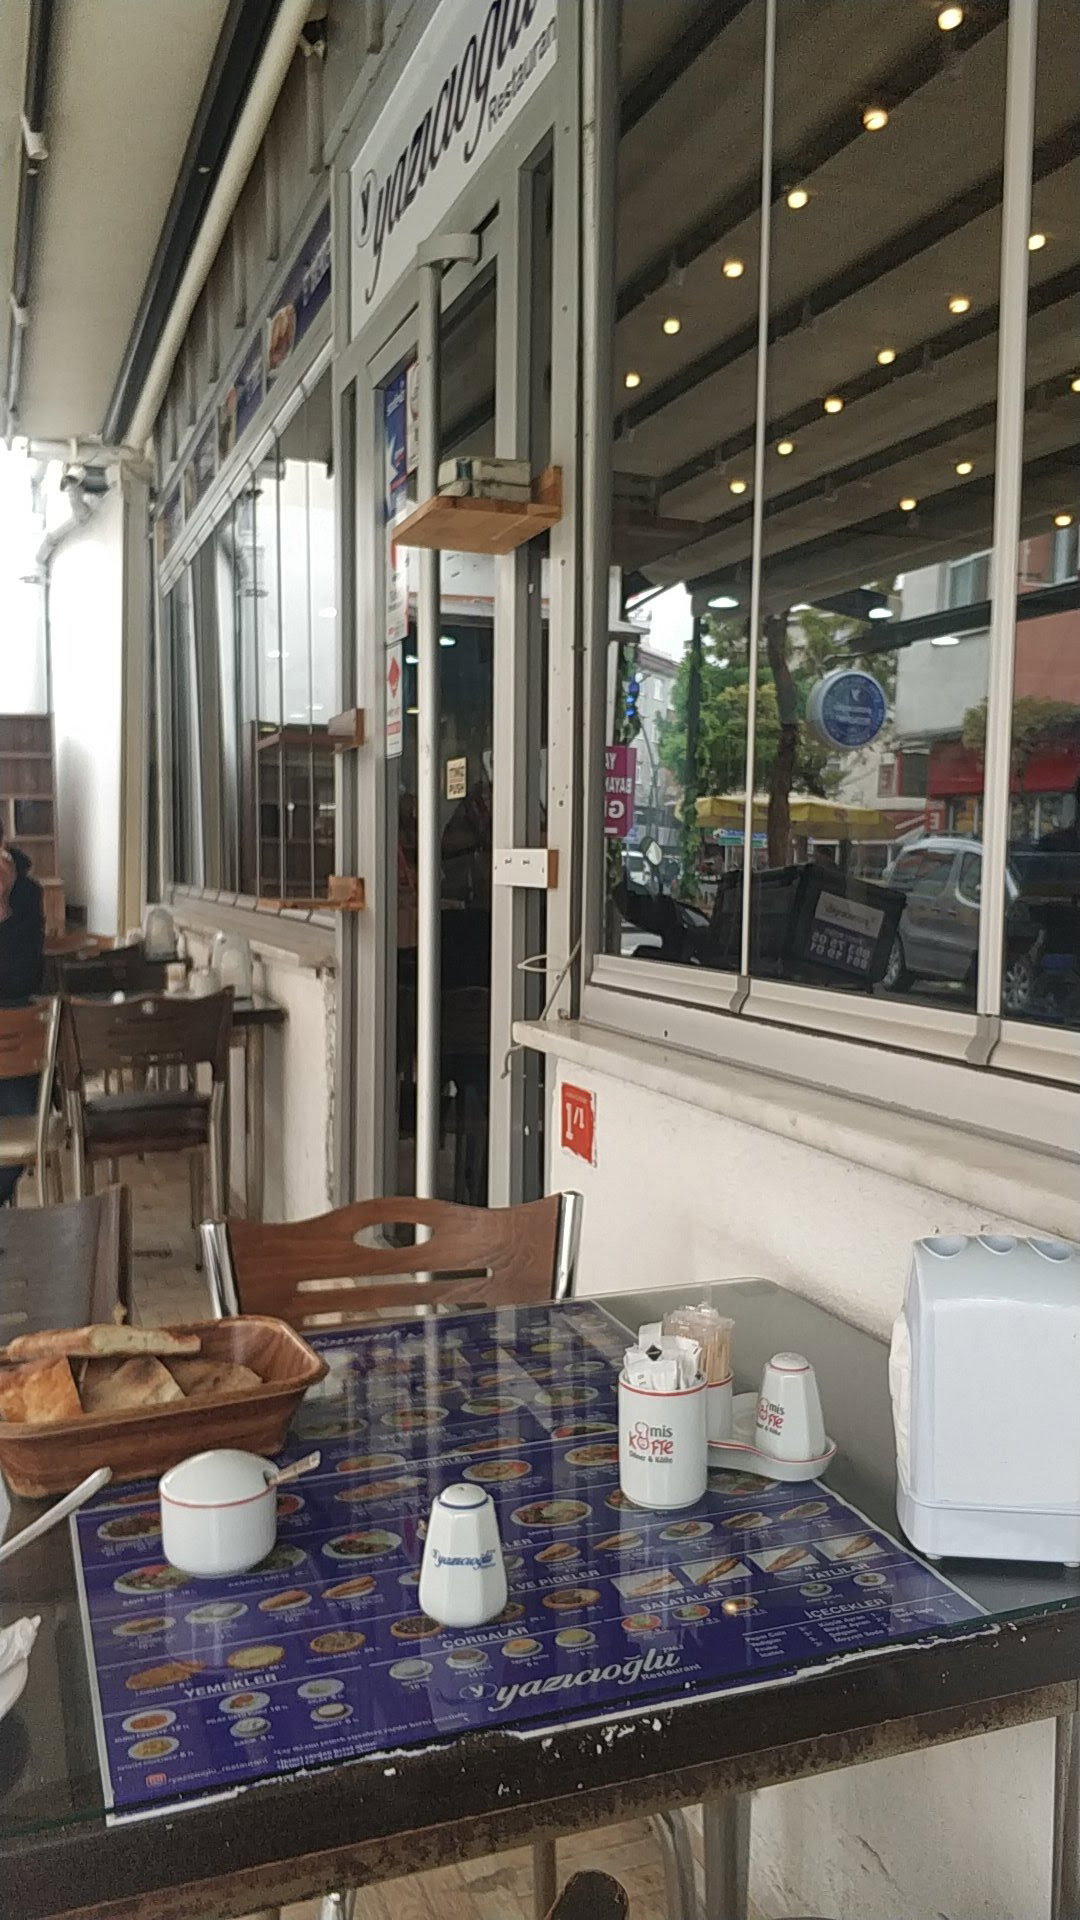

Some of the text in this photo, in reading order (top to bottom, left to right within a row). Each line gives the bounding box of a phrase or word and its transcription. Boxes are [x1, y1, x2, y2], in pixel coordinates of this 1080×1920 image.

[650, 1424, 674, 1438] mis
[540, 1569, 602, 1587] PİDELER
[805, 1562, 871, 1581] TATLILAR
[639, 1589, 725, 1612] SALATALAR
[804, 1598, 887, 1620] İÇECEKLER
[441, 1626, 530, 1651] ÇORBALAR
[487, 1647, 682, 1713] yazıcıoğlu
[640, 1663, 702, 1681] Restaurant
[183, 1673, 278, 1700] YEMEKLER
